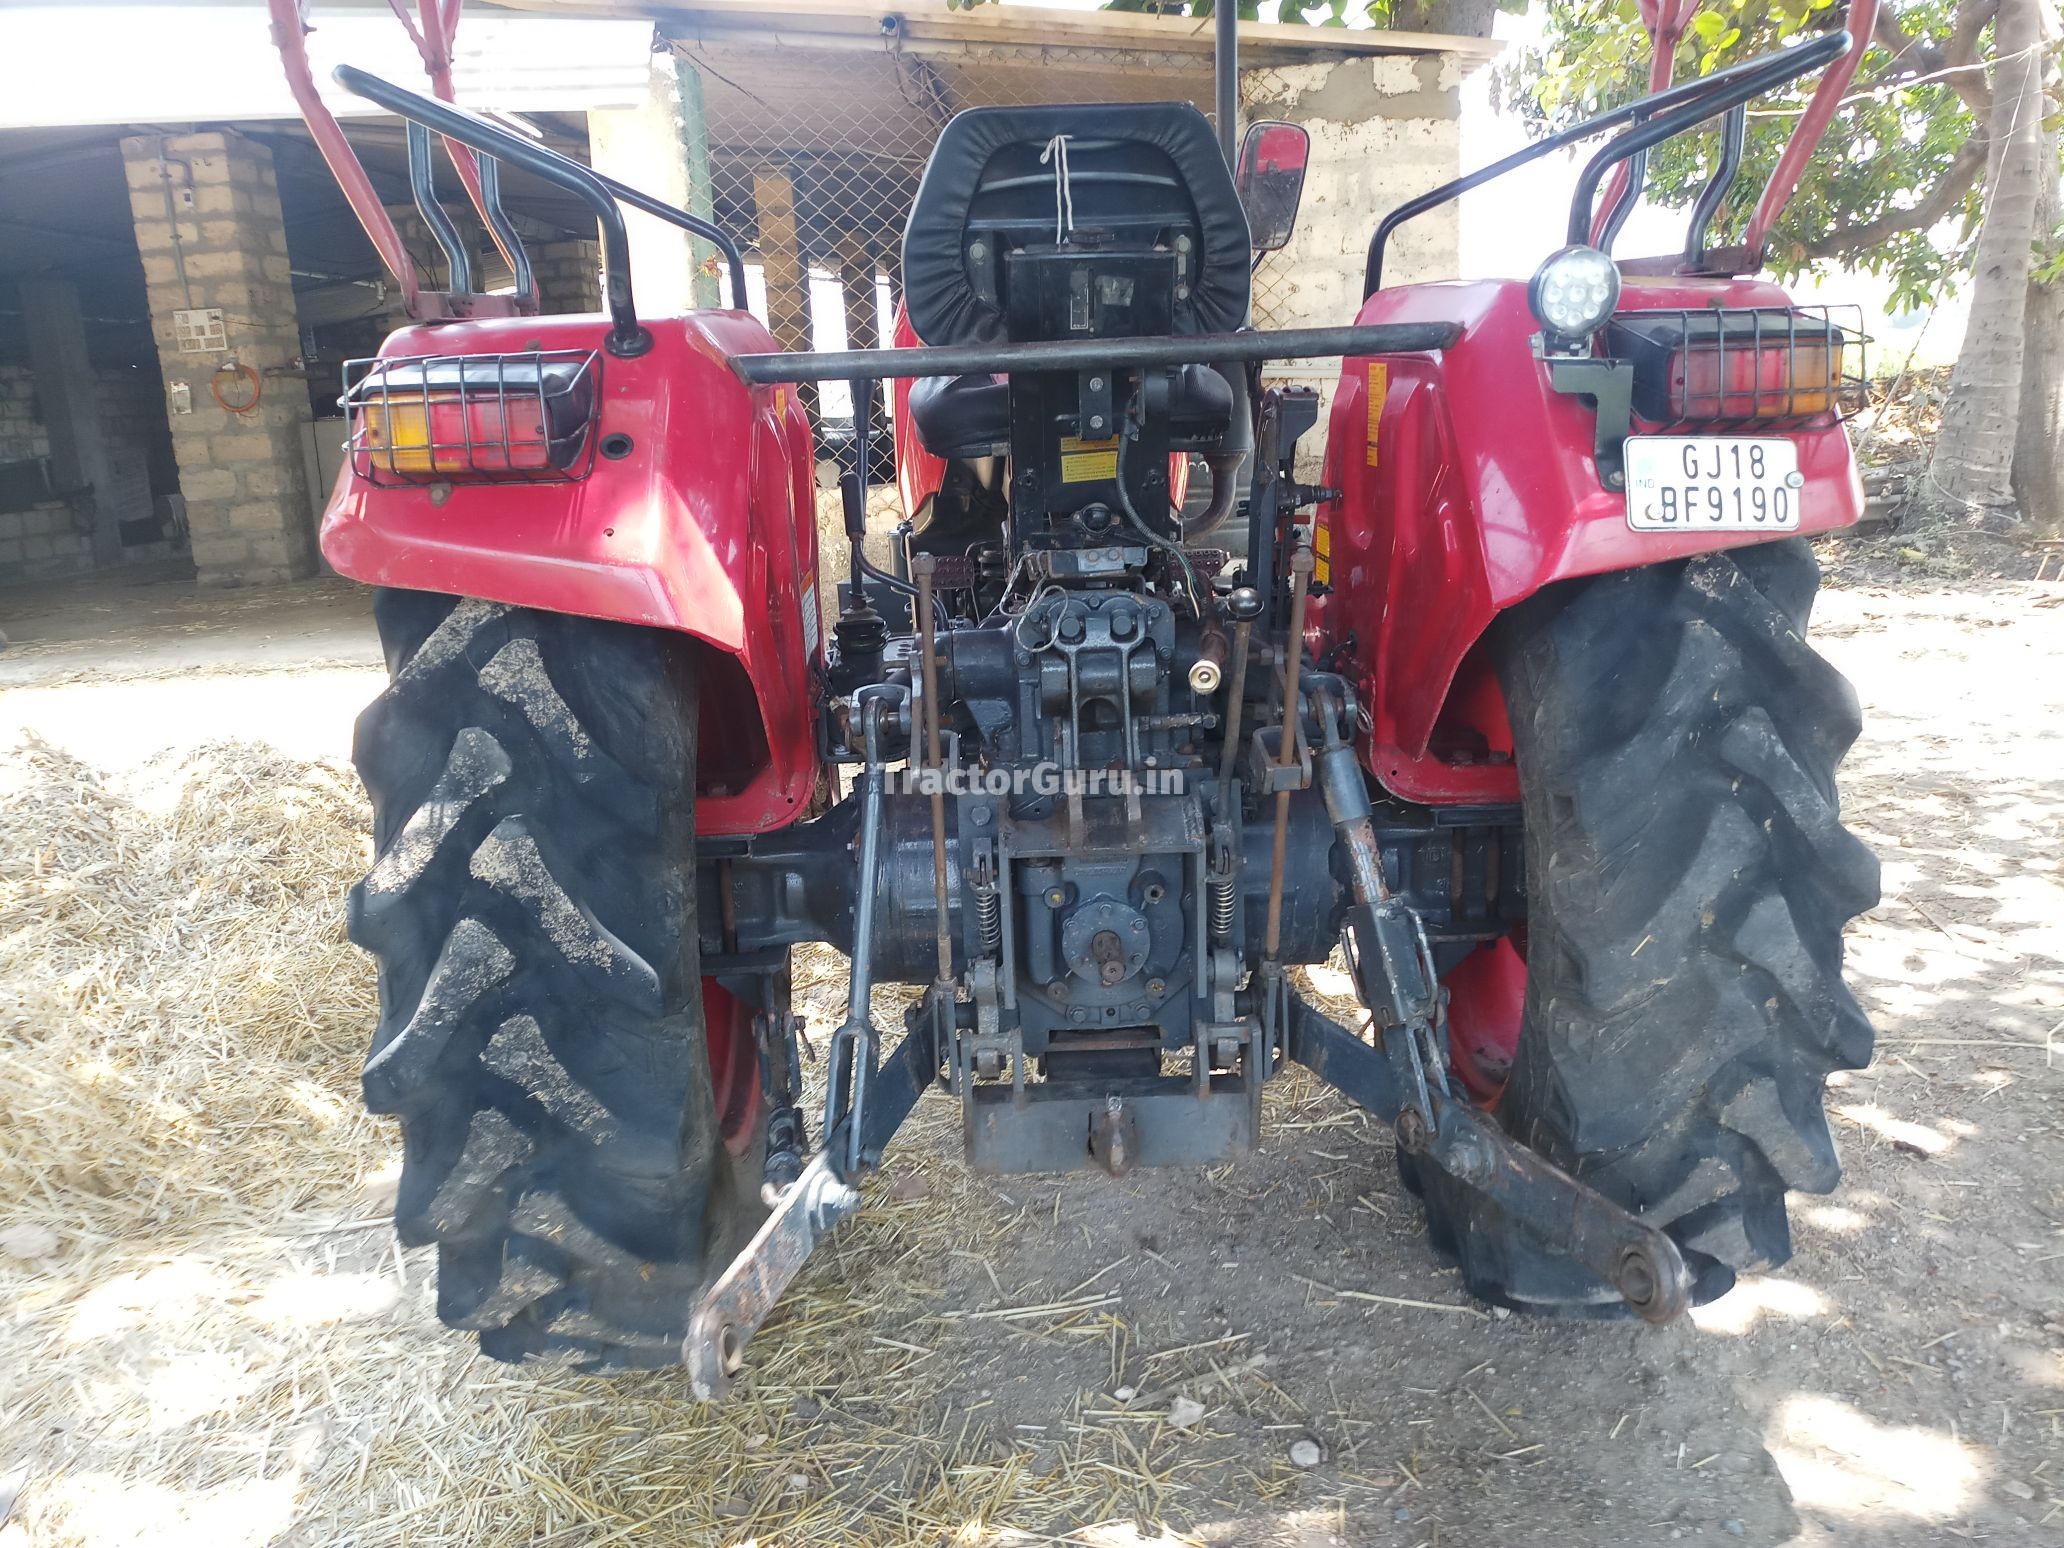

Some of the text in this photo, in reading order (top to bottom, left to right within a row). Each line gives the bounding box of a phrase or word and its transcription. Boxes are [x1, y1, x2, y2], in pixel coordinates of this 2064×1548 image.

[1682, 444, 1765, 479] GJ18
[1635, 478, 1655, 489] IND
[1661, 486, 1788, 523] BF9190
